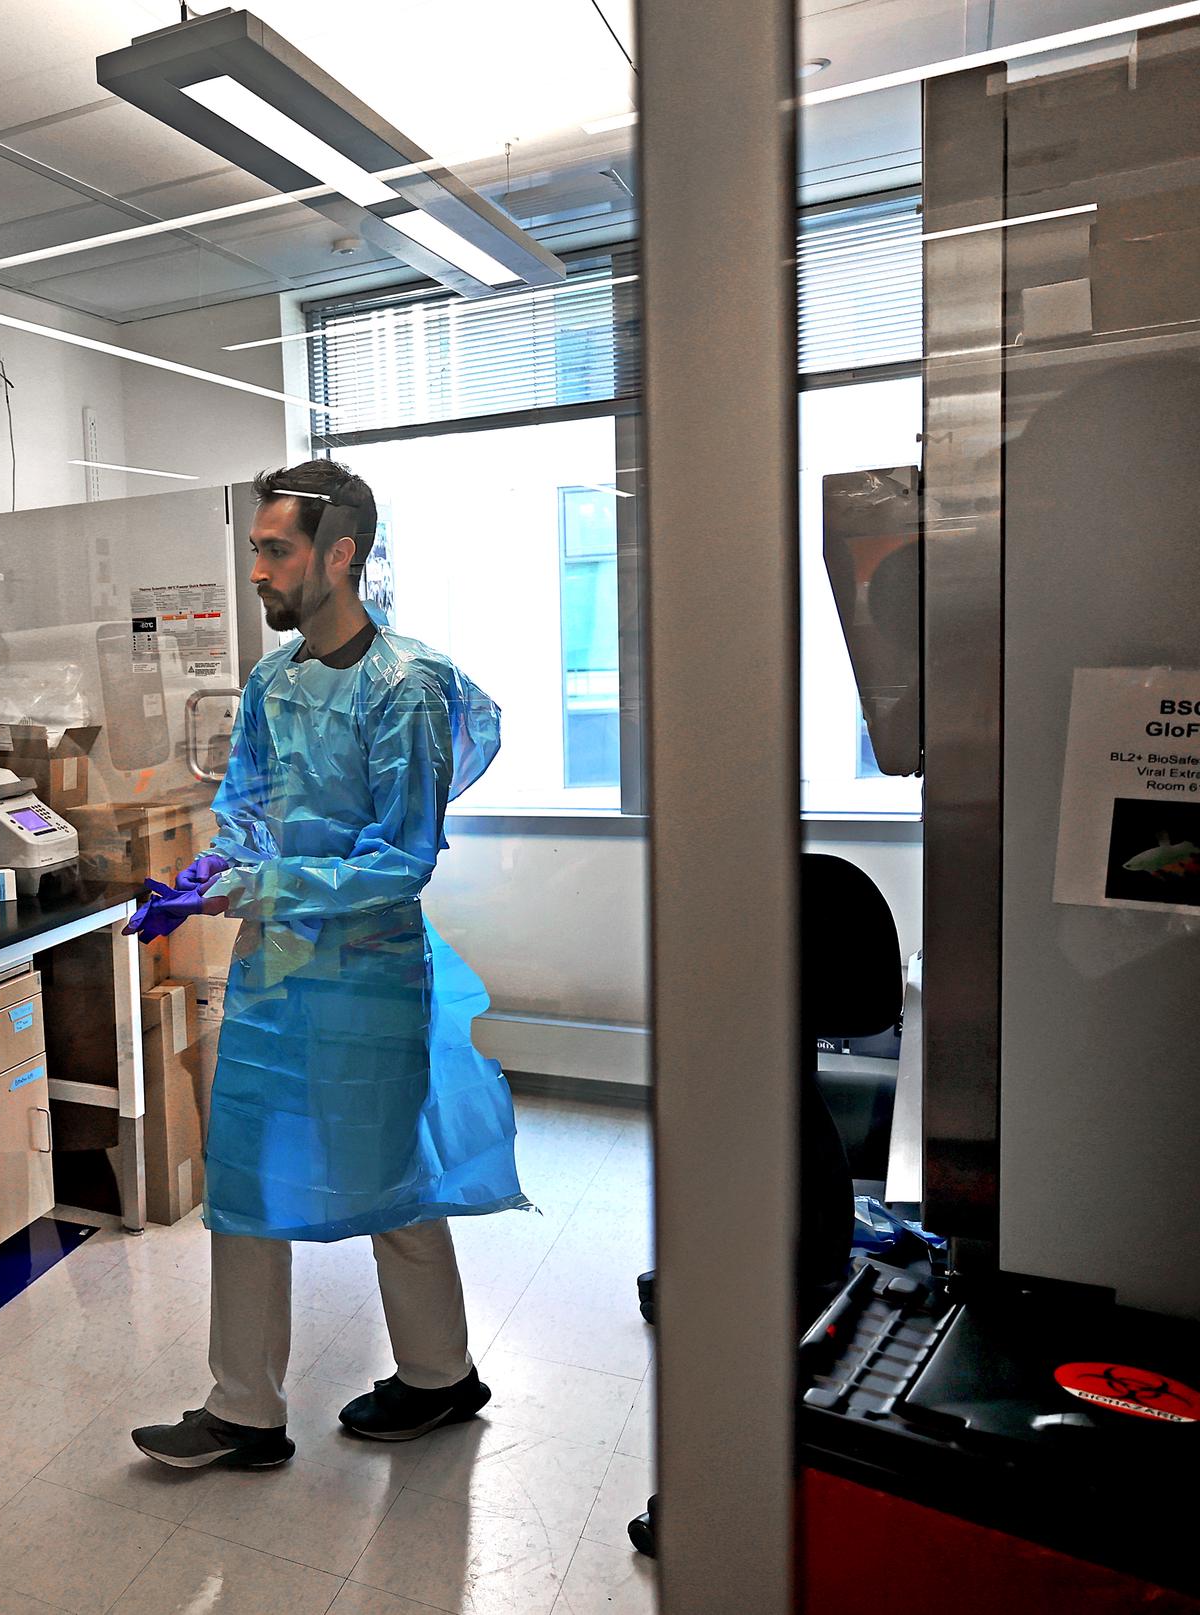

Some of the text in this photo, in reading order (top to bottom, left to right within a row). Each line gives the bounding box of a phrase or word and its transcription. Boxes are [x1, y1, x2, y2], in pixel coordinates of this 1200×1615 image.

[1110, 752, 1143, 762] BL2+
[1138, 767, 1165, 777] Viral
[1146, 780, 1185, 792] Room
[1077, 1391, 1184, 1422] BIOHAZARD
